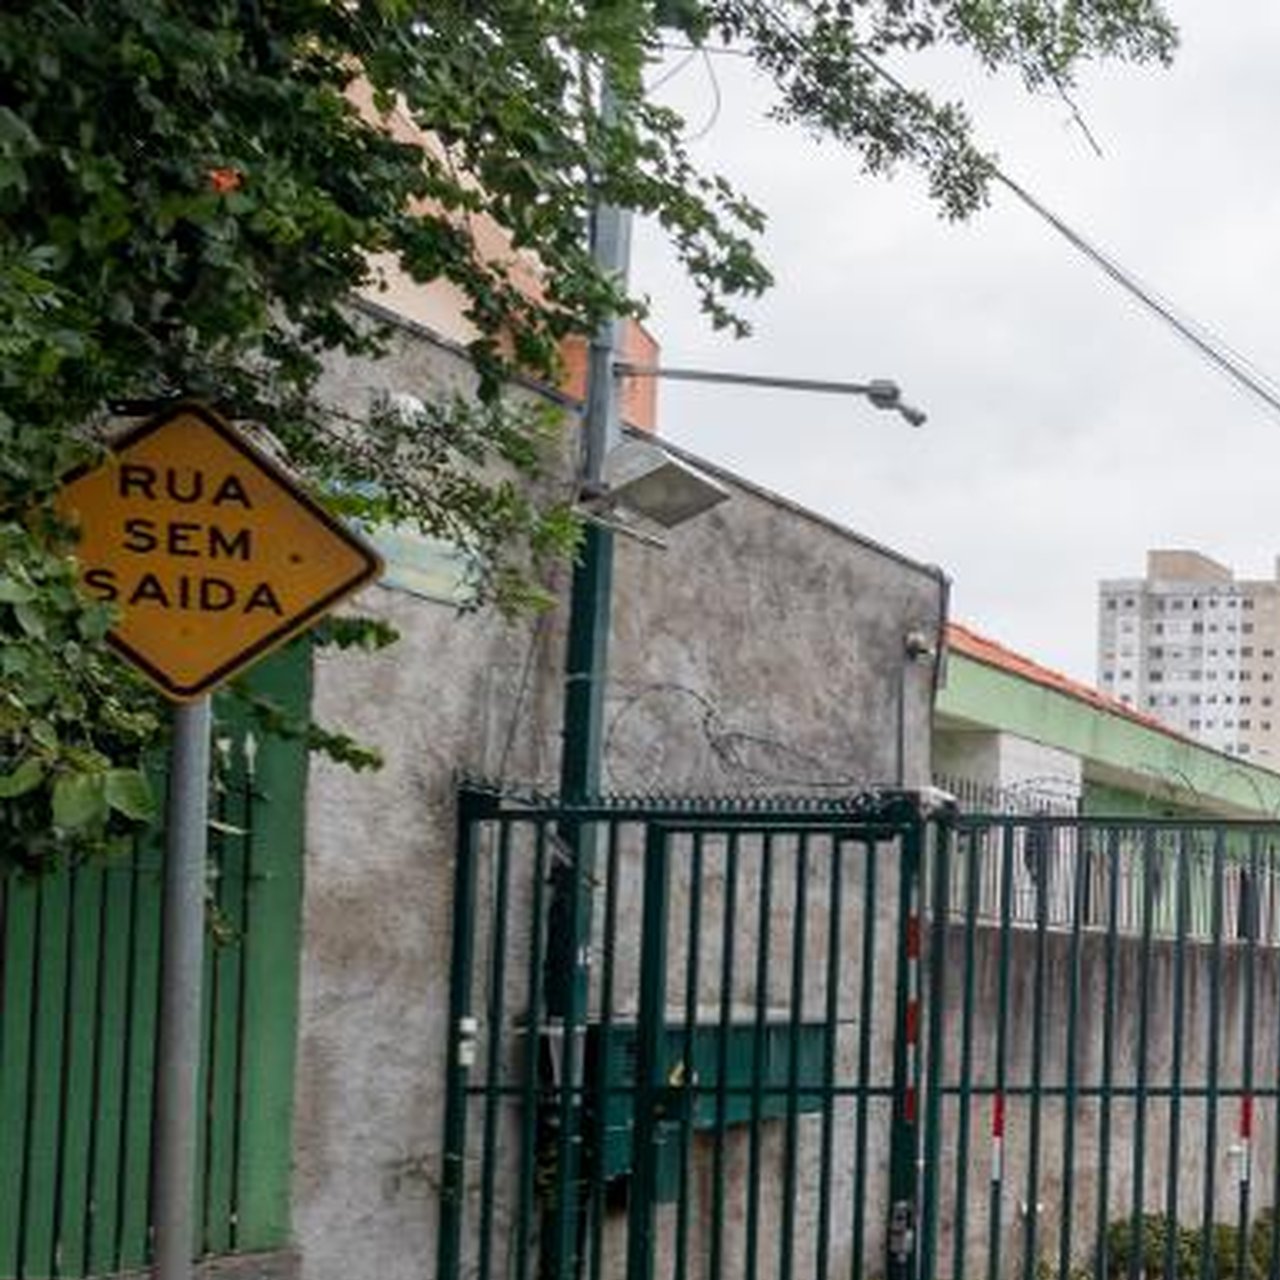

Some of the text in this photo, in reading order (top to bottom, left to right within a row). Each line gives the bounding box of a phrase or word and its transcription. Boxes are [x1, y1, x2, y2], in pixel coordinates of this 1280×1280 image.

[119, 465, 251, 509] RUA
[123, 519, 251, 561] SEM
[84, 569, 284, 616] SAIDA
